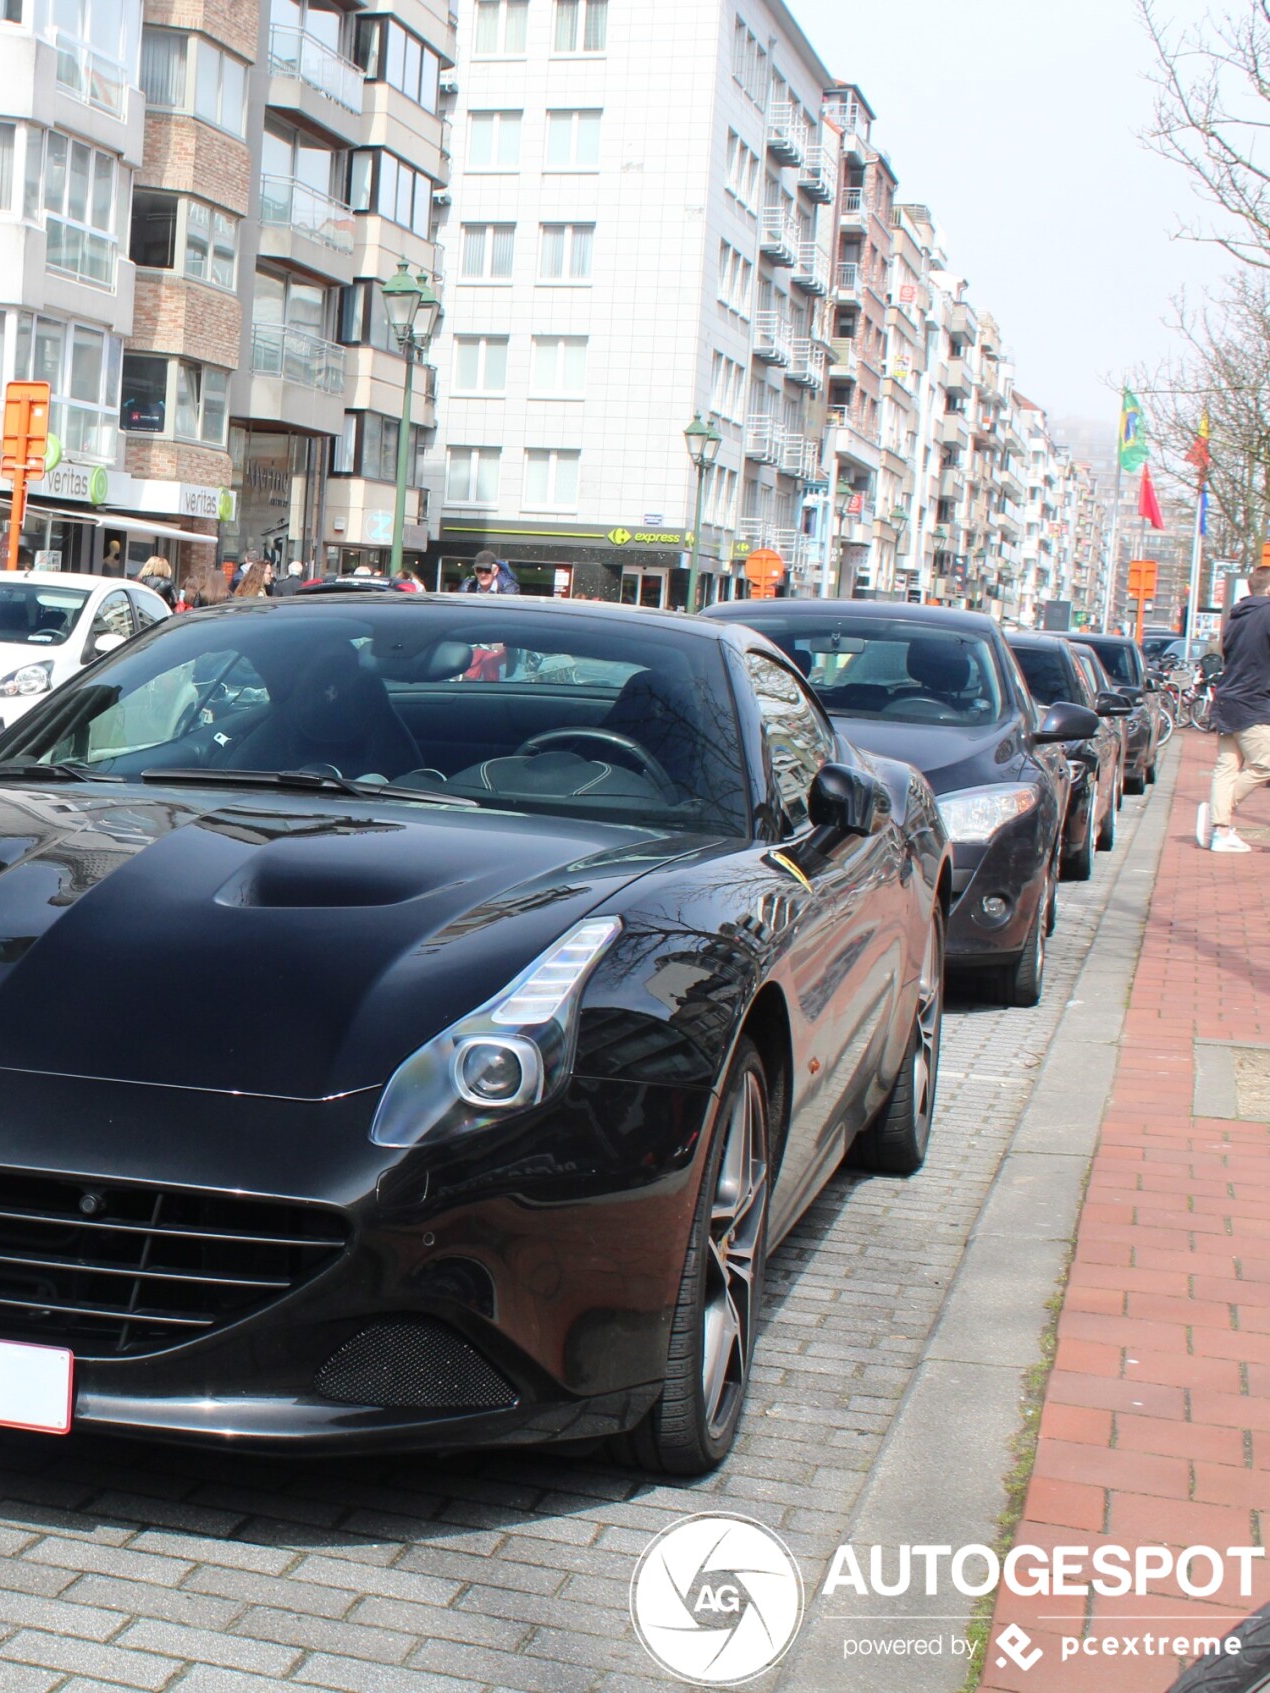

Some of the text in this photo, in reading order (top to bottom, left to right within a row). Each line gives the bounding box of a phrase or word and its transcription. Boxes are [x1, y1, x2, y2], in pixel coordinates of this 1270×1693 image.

[47, 469, 88, 497] veritas
[185, 490, 217, 515] veritas
[634, 532, 680, 545] express
